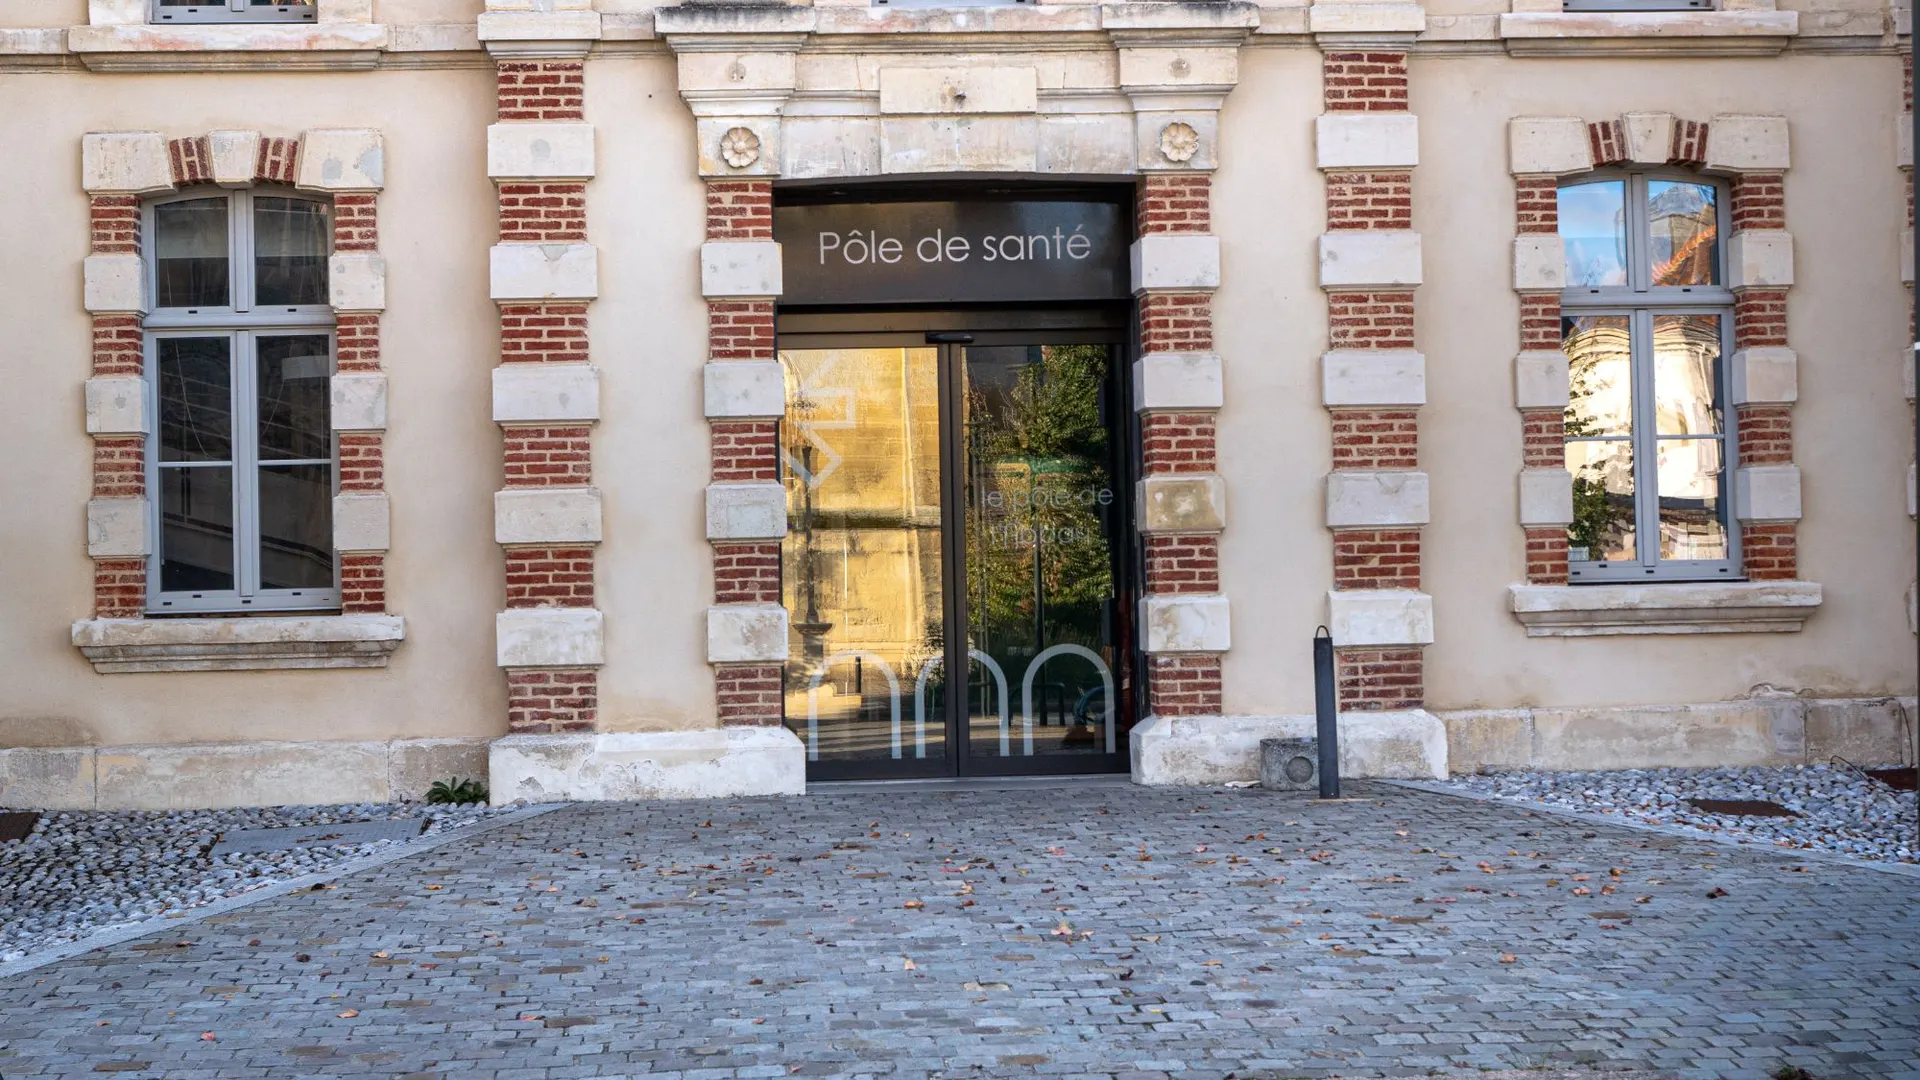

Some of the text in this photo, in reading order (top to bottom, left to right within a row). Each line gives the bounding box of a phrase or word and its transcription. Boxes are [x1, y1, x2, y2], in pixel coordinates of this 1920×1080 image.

[818, 223, 1092, 265] Pôle de santé
[1079, 483, 1114, 506] de
